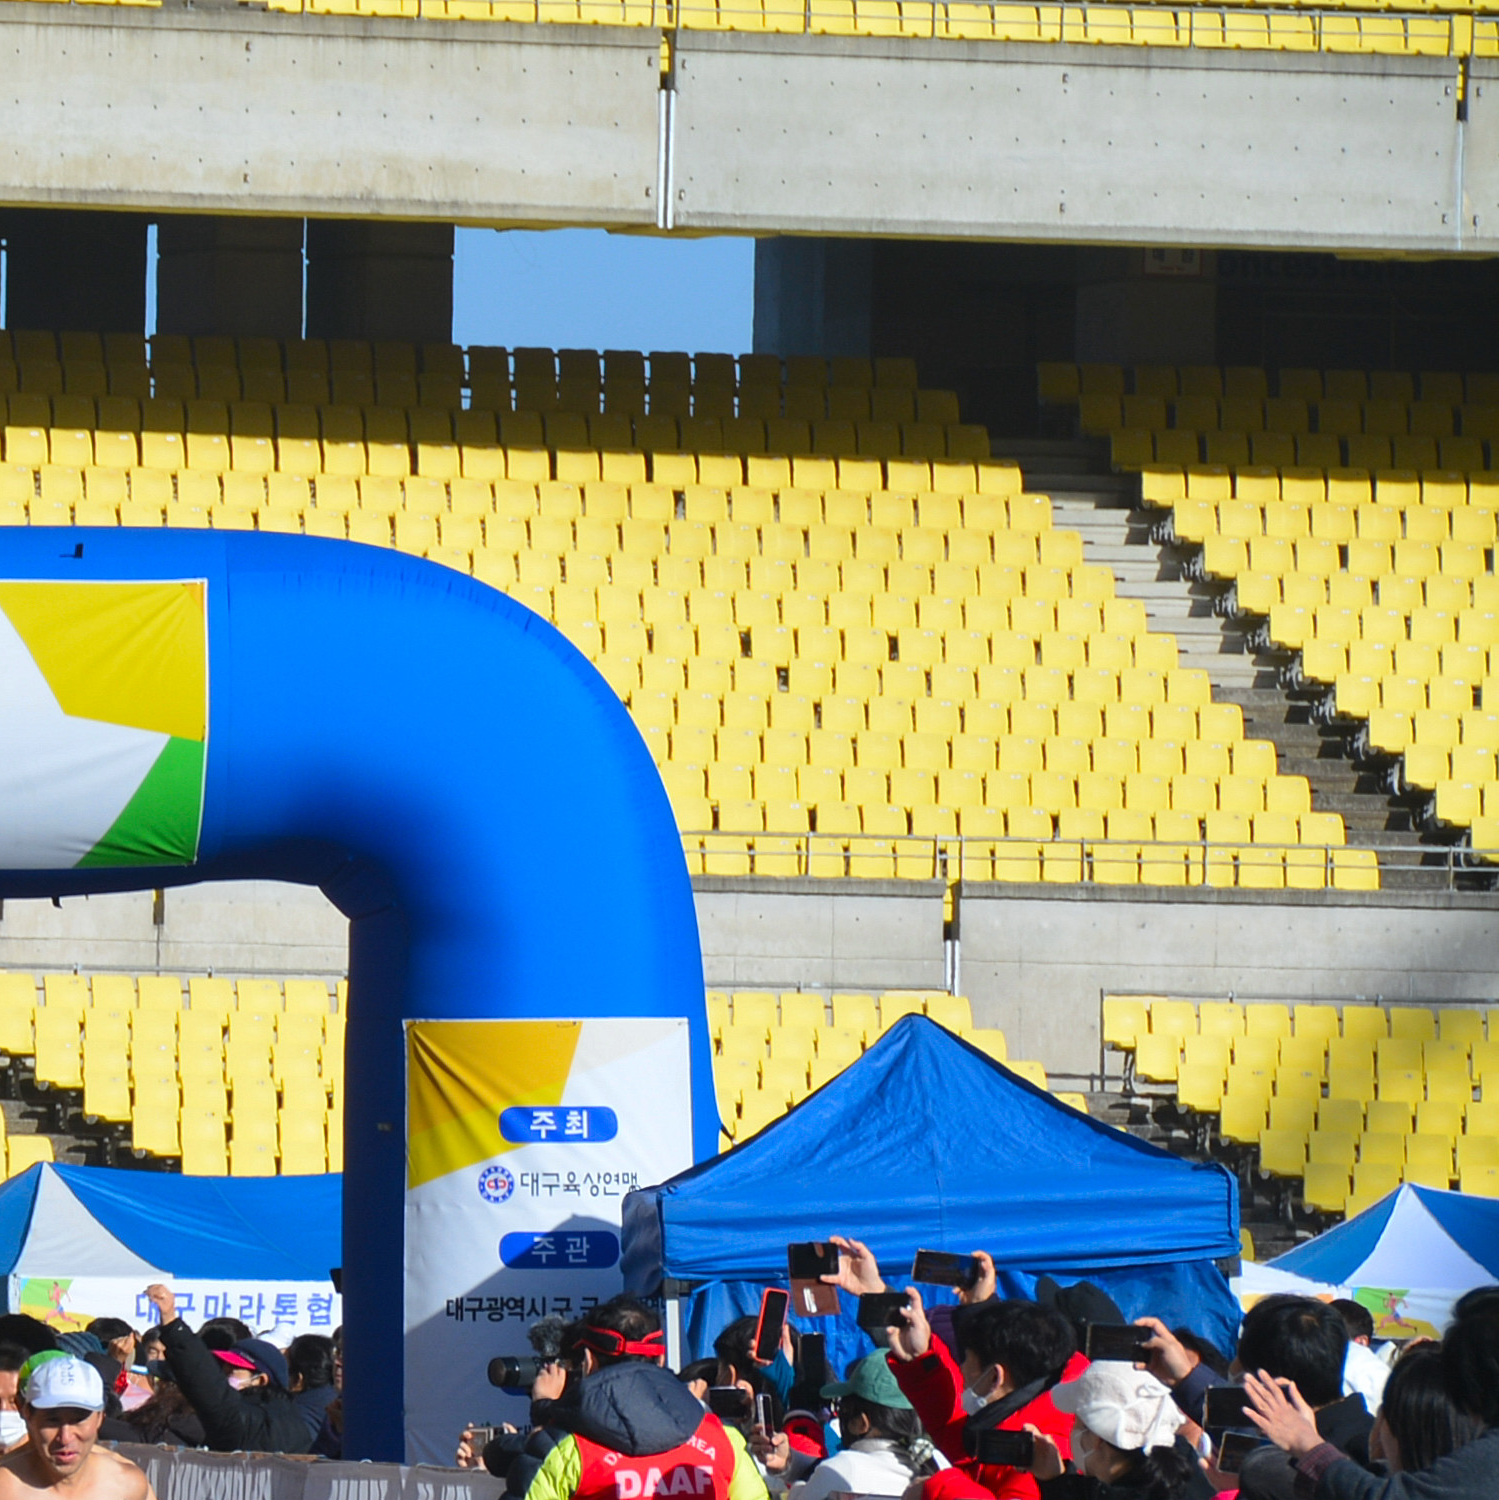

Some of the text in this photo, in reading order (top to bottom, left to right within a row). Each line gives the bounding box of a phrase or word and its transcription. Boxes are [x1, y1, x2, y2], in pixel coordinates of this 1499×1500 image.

[520, 1171, 639, 1198] 대구육상연맹
[135, 1291, 333, 1327] 대구마라톤협
[615, 1464, 714, 1500] DAAF
